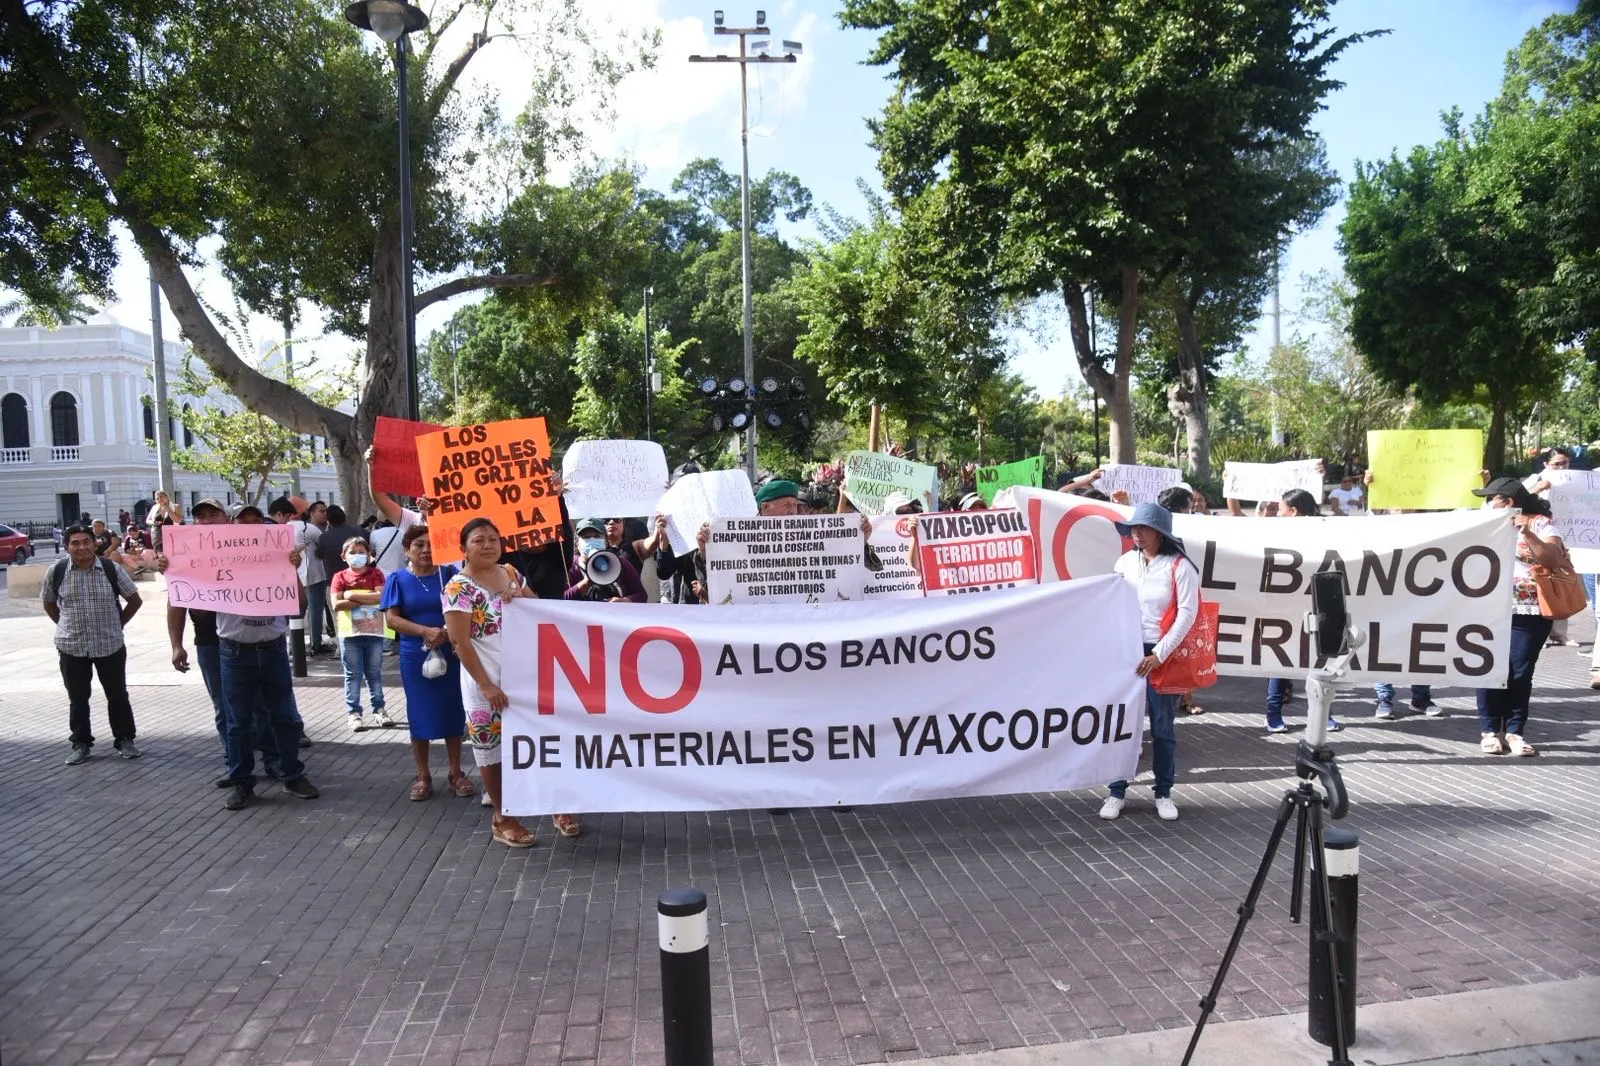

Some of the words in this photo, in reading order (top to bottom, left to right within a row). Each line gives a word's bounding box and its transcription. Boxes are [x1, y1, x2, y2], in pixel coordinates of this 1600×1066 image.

[443, 425, 488, 448] LOS
[440, 439, 537, 473] ARBOLES
[848, 455, 862, 468] NO
[863, 457, 872, 469] AL
[874, 458, 901, 473] BANCO
[433, 472, 463, 496] NO
[474, 457, 553, 486] GRITAN
[848, 465, 893, 482] MATERIALES
[979, 468, 999, 483] NO
[427, 491, 482, 516] PERO
[494, 484, 521, 505] YO
[530, 478, 559, 498] SI
[515, 507, 546, 528] LA
[727, 520, 737, 531] EL
[738, 518, 782, 531] CHAPULÍN
[784, 519, 818, 530] GRANDE
[820, 518, 827, 528] Y
[828, 517, 845, 528] SUS
[920, 511, 1027, 540] YAXCOPOIL
[264, 529, 290, 550] NO
[432, 526, 461, 550] NO
[499, 524, 566, 552] NERIA
[712, 531, 783, 543] CHAPULINCITOS
[785, 529, 812, 542] ESTÁN
[813, 528, 858, 540] COMIENDO
[1028, 498, 1136, 584] O
[1563, 528, 1600, 544] AQ
[747, 544, 772, 555] TODA
[772, 543, 783, 554] LA
[784, 541, 825, 553] COSECHA
[898, 542, 909, 552] de
[933, 538, 1023, 566] TERRITORIO
[710, 558, 749, 571] PUEBLOS
[750, 556, 807, 569] ORIGINARIOS
[809, 556, 820, 567] EN
[822, 554, 854, 566] RUINAS
[855, 554, 861, 564] Y
[882, 556, 908, 566] ruido,
[216, 569, 234, 581] ES
[736, 570, 796, 583] DEVASTACIÓN
[797, 569, 824, 581] TOTAL
[826, 569, 836, 579] DE
[939, 560, 1022, 586] PROHIBIDO
[171, 580, 296, 604] DESTRUCCION
[748, 585, 766, 596] SUS
[767, 583, 825, 596] TERRITORIOS
[863, 581, 915, 594] destrucción
[538, 623, 702, 715] NO
[716, 644, 742, 676] A
[753, 642, 828, 674] LOS
[840, 626, 996, 668] BANCOS
[512, 735, 561, 770] DE
[575, 727, 815, 770] MATERIALES
[828, 724, 876, 761] EN
[892, 703, 1132, 757] YAXCOPOIL
